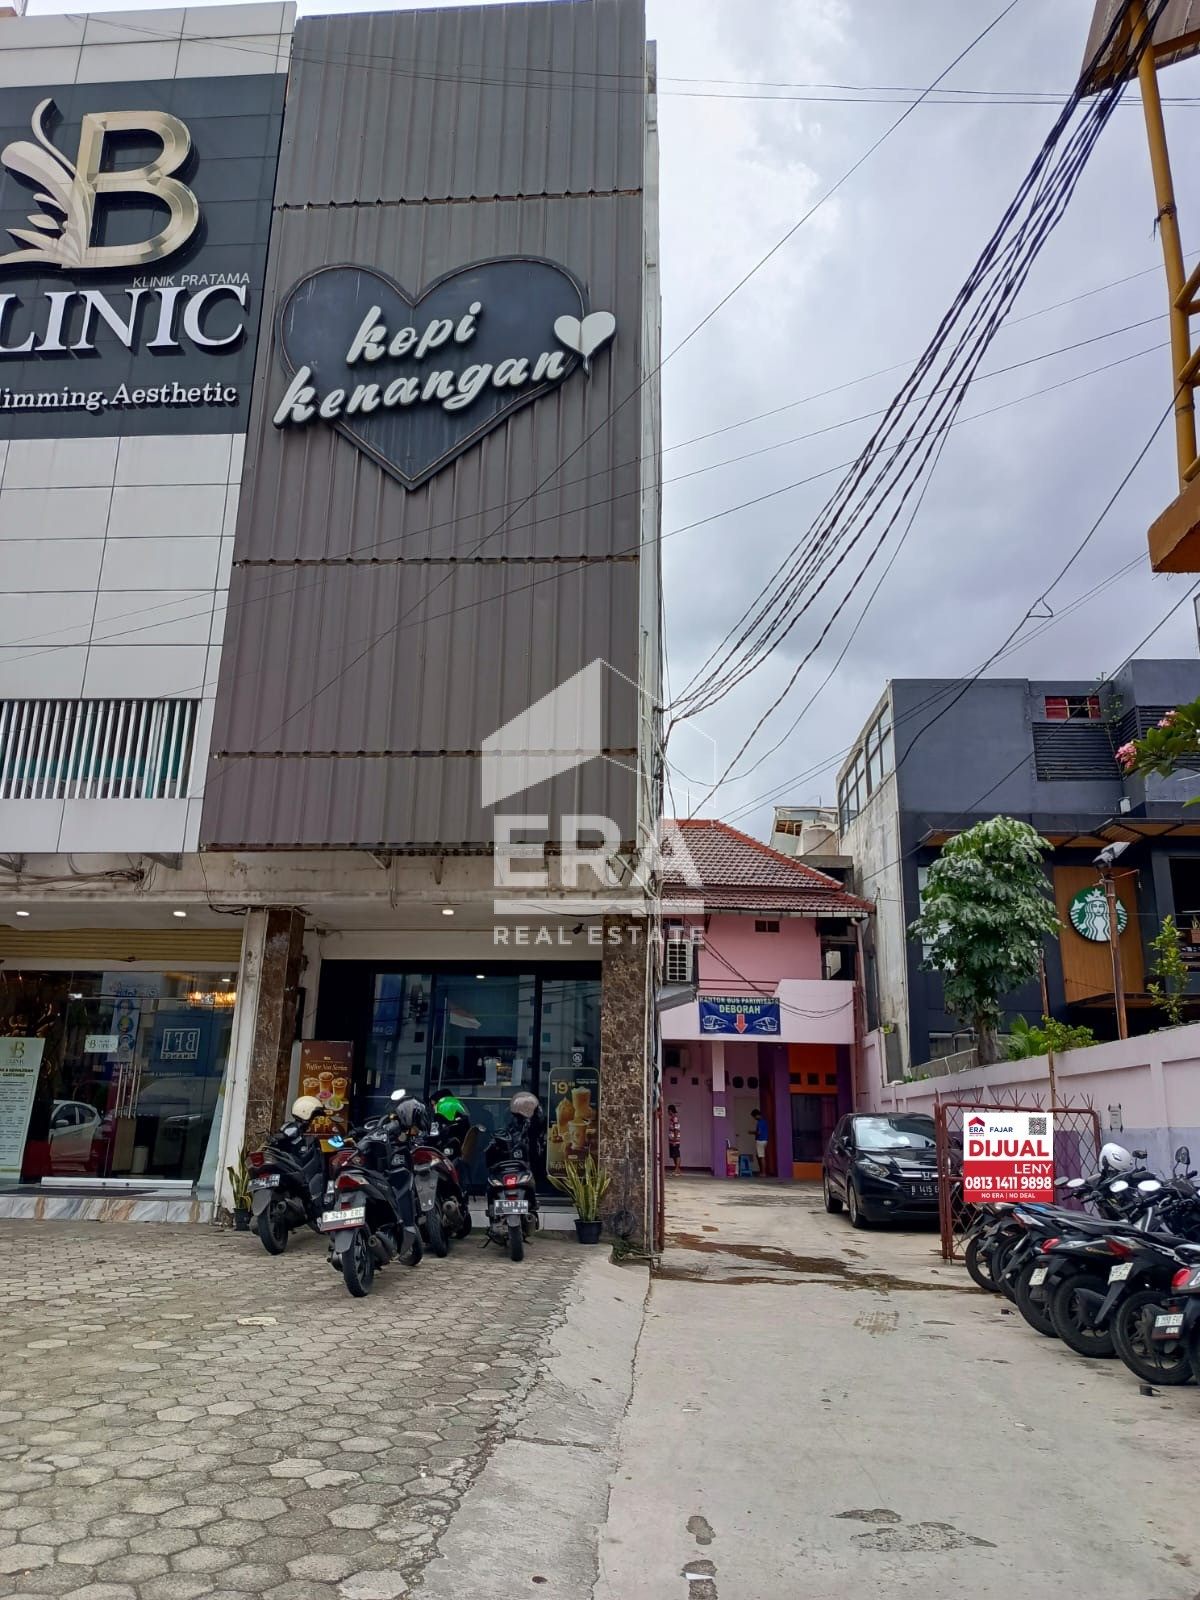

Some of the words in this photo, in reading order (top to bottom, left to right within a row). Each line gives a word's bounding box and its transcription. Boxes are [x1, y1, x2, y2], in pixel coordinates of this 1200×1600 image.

[133, 275, 175, 288] KLINIK
[181, 272, 251, 286] PRATAMA
[346, 302, 482, 363] kopi
[273, 351, 566, 423] kenangan
[719, 1004, 761, 1014] DEBORAH
